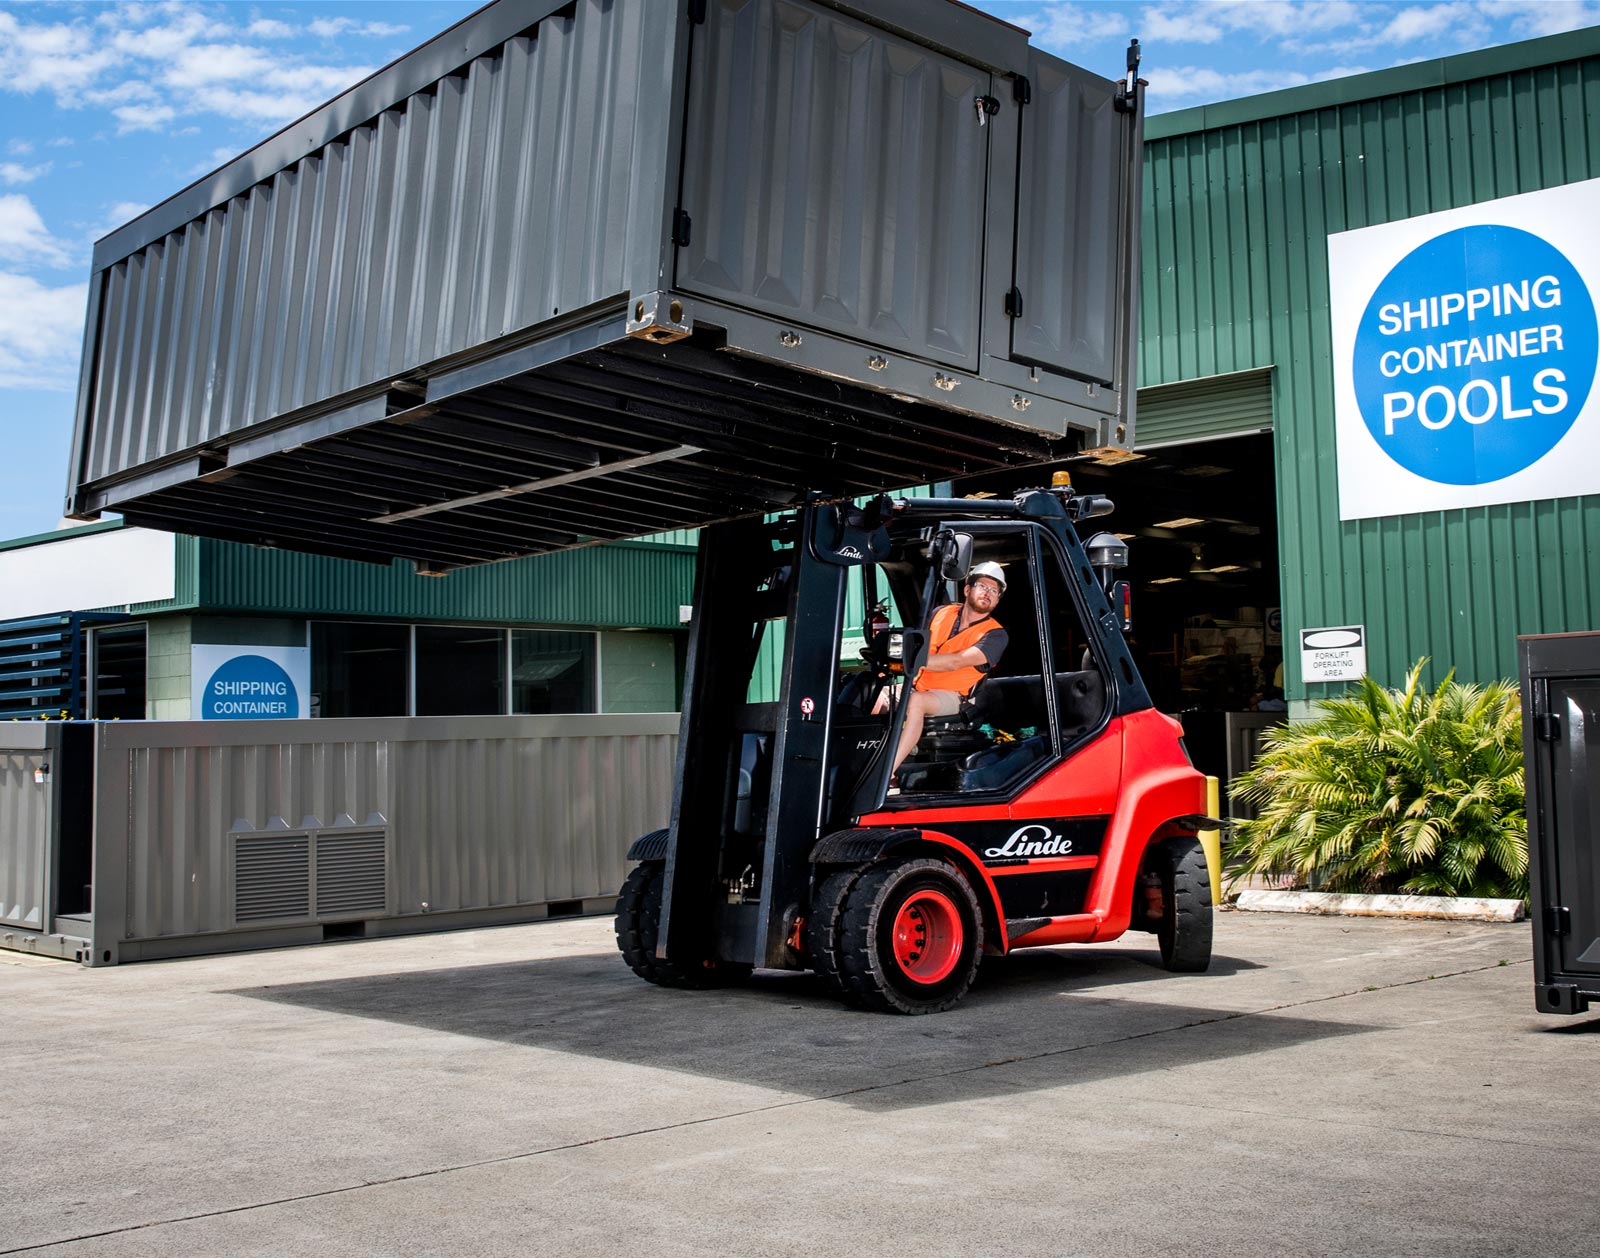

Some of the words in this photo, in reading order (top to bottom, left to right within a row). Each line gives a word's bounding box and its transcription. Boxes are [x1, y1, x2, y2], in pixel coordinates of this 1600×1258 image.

[1378, 275, 1562, 336] SHIPPING
[1379, 324, 1564, 378] CONTAINER
[1383, 368, 1569, 436] POOLS
[833, 545, 864, 560] Linde
[1314, 650, 1350, 660] FORKLIFT
[1312, 660, 1353, 669] OPERATING
[1324, 669, 1343, 677] AREA
[214, 681, 287, 696] SHIPPING
[213, 701, 287, 714] CONTAINER
[984, 824, 1073, 858] Linde
